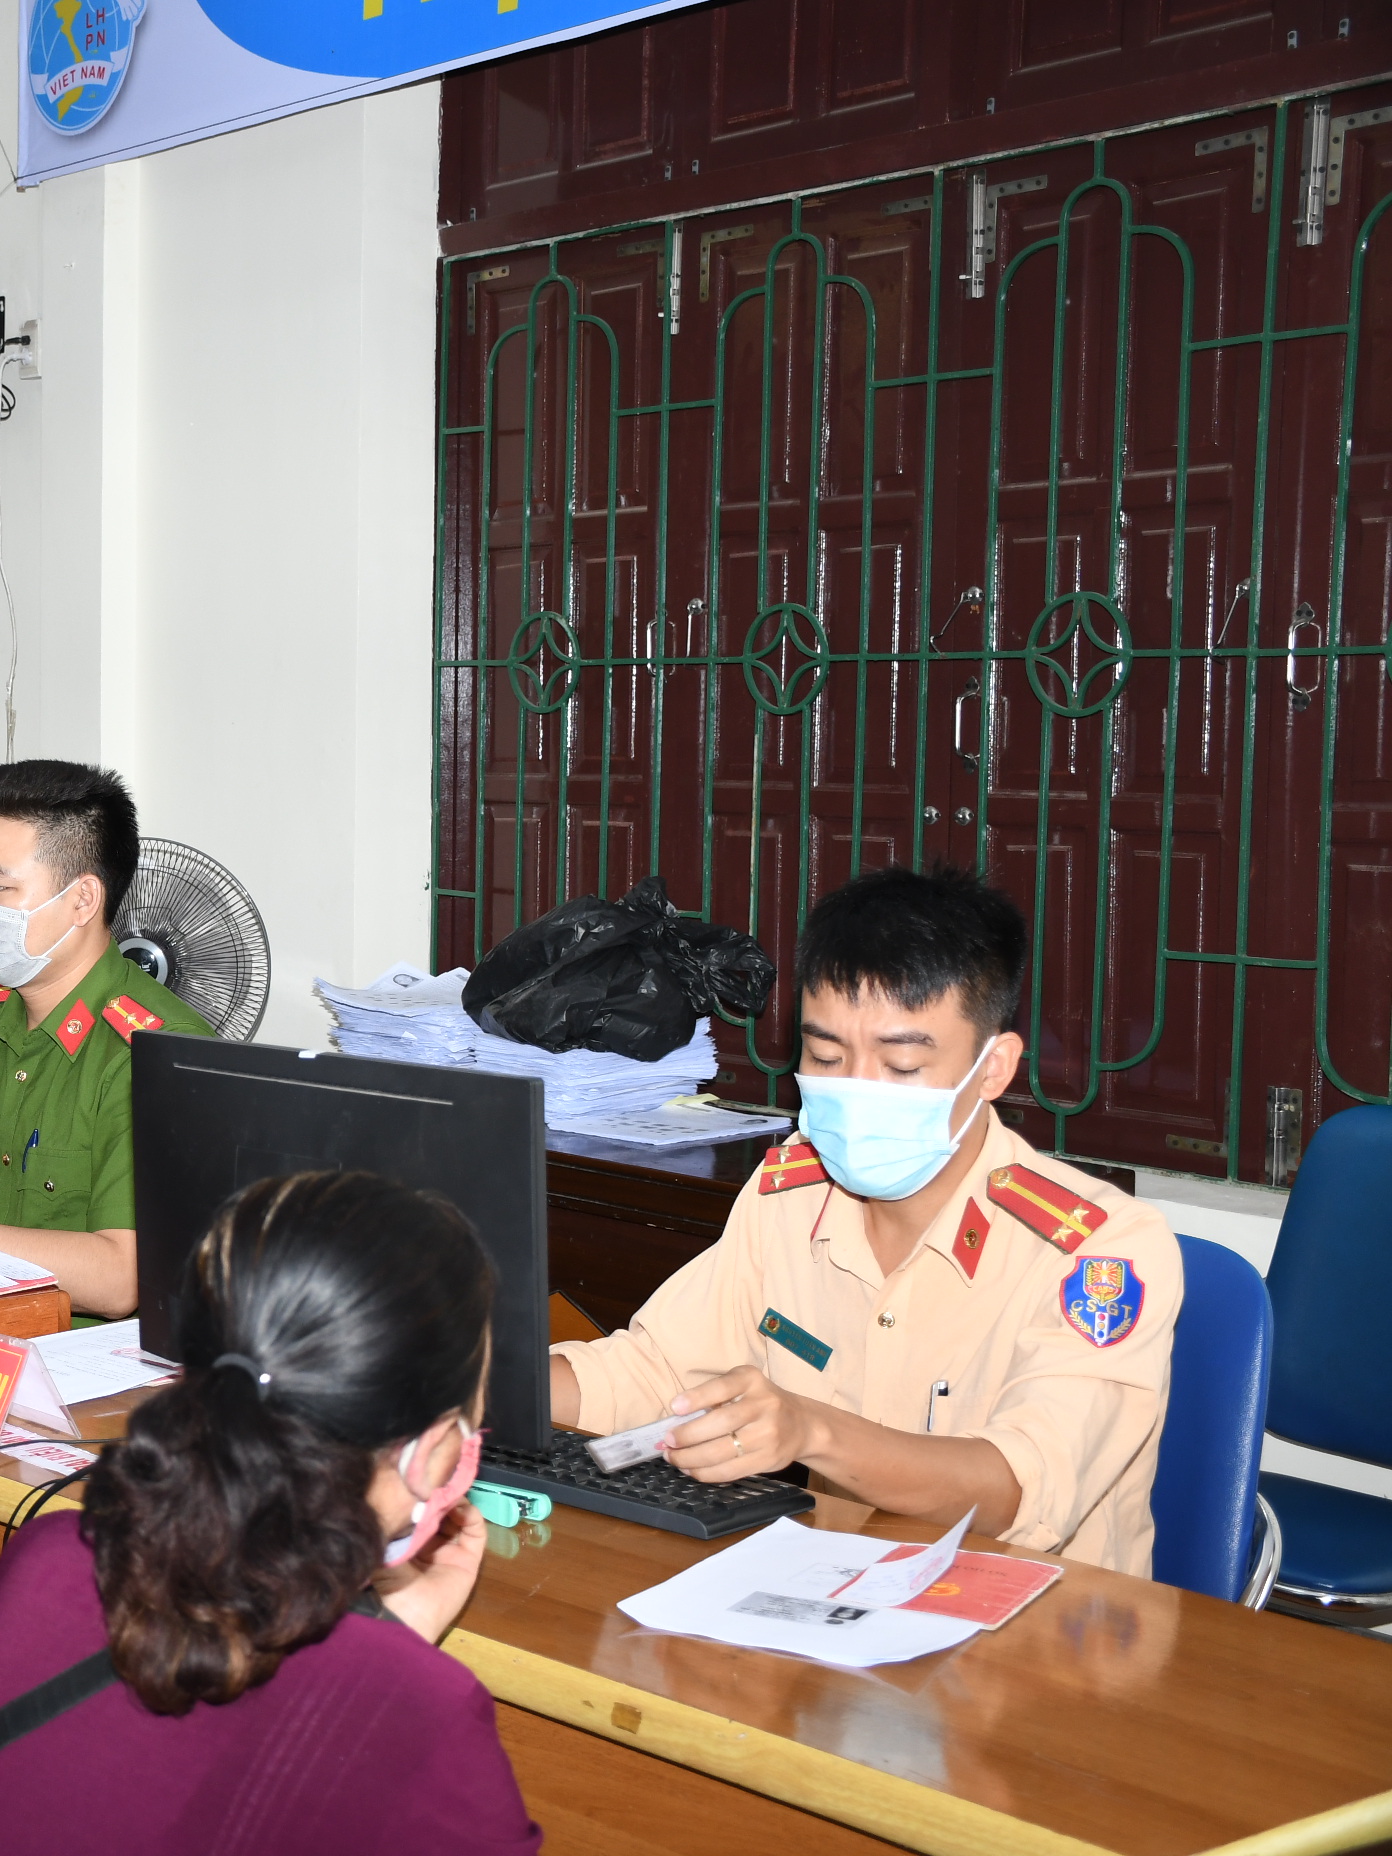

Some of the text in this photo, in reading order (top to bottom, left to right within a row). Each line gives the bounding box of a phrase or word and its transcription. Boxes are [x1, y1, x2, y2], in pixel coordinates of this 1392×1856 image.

[86, 7, 106, 29] LH
[86, 29, 106, 51] PN
[80, 65, 106, 81] NAM
[1071, 1299, 1133, 1319] CSGT
